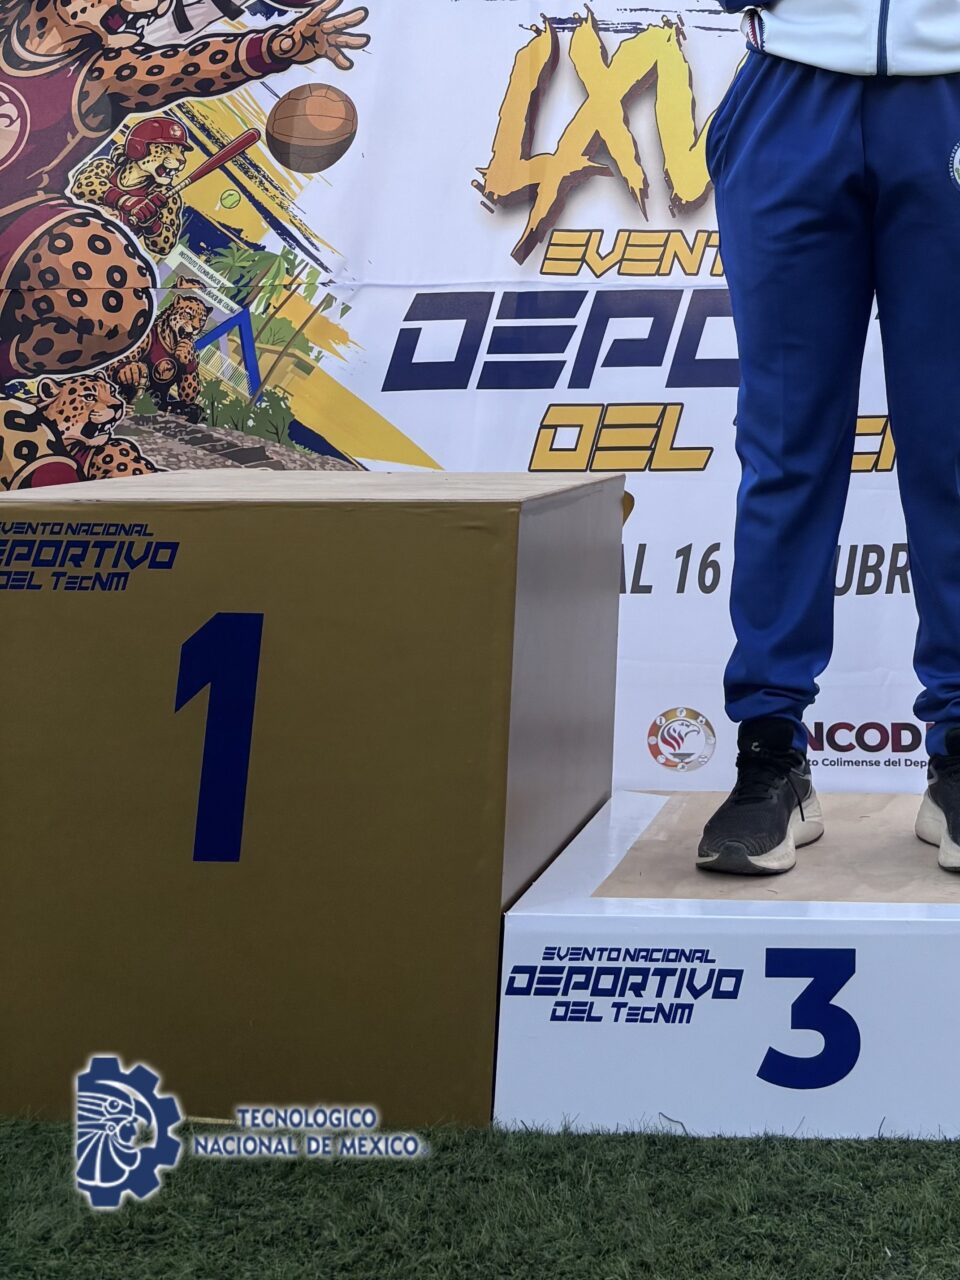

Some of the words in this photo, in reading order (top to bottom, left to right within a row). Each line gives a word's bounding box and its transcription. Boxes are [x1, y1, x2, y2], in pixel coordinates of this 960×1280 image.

[540, 229, 726, 278] EVENT
[528, 403, 714, 472] DEL
[0, 521, 64, 535] VENTO
[65, 523, 154, 537] NACIONAL
[0, 539, 180, 570] PORTIVO
[674, 542, 722, 595] 16
[174, 611, 264, 862] 1
[806, 721, 934, 753] NCOD
[822, 757, 881, 768] Colimense
[884, 758, 901, 768] del
[542, 946, 622, 962] EVENTO
[622, 947, 716, 964] NACIONAL
[505, 965, 745, 1000] DEPORTIVO
[550, 1001, 603, 1022] DEL
[756, 947, 861, 1090] 3
